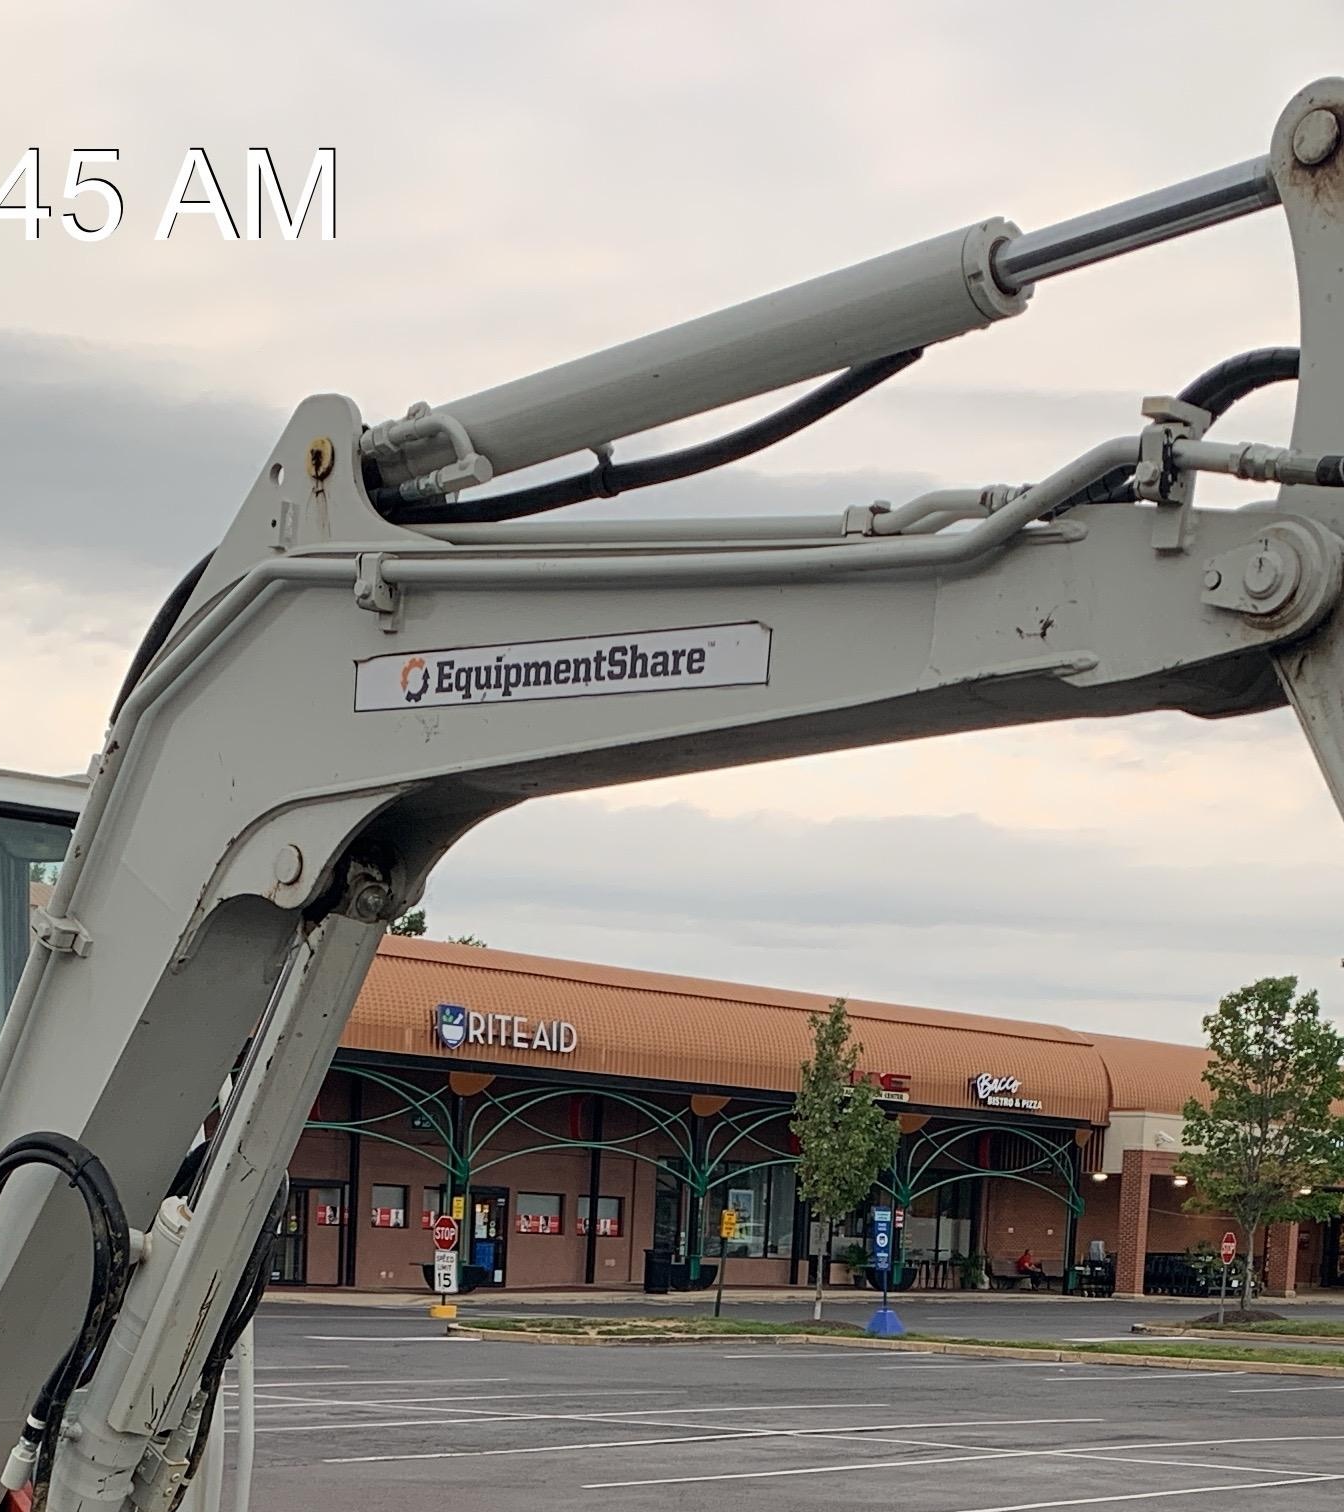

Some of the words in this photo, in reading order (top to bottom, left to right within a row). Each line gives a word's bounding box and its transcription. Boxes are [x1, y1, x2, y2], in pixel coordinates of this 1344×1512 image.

[436, 644, 706, 699] EquipmentShare
[468, 1011, 529, 1049] RITE
[532, 1021, 577, 1053] AID
[988, 1096, 1014, 1108] BISTRO
[1014, 1099, 1021, 1108] &
[1021, 1099, 1042, 1110] PIZZA
[436, 1226, 456, 1241] STOP
[436, 1254, 454, 1263] SPEED
[437, 1273, 452, 1288] 15
